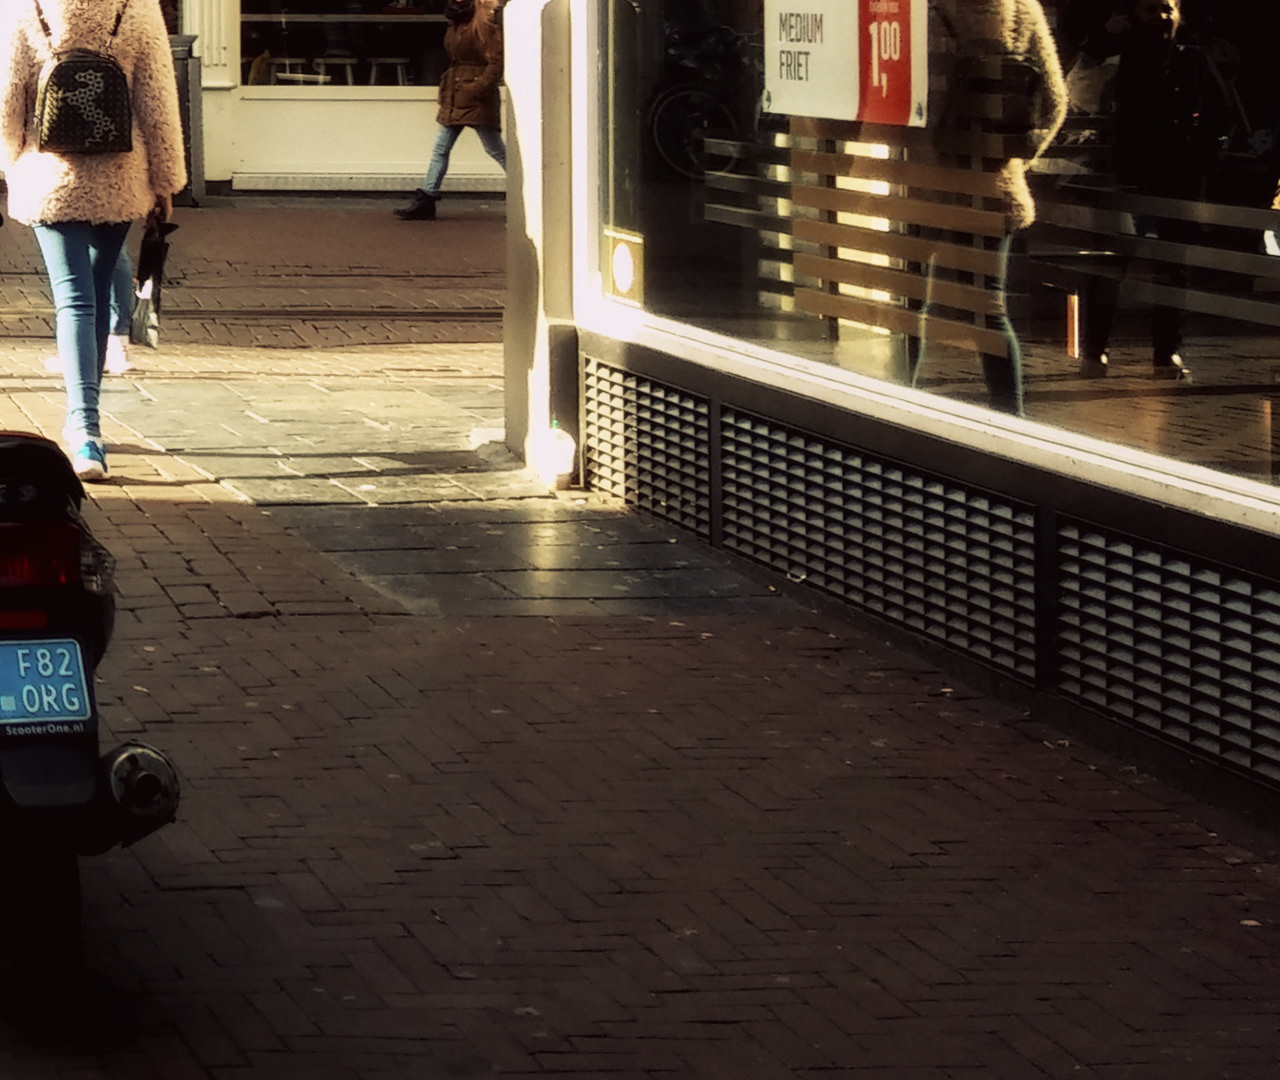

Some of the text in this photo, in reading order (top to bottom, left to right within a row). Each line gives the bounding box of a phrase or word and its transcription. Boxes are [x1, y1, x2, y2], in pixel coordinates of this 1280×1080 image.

[779, 12, 823, 44] MEDIUM
[779, 50, 810, 81] FRIET
[17, 648, 74, 677] F82
[22, 683, 81, 713] ORG
[5, 723, 84, 736] ScooterOne.nl
